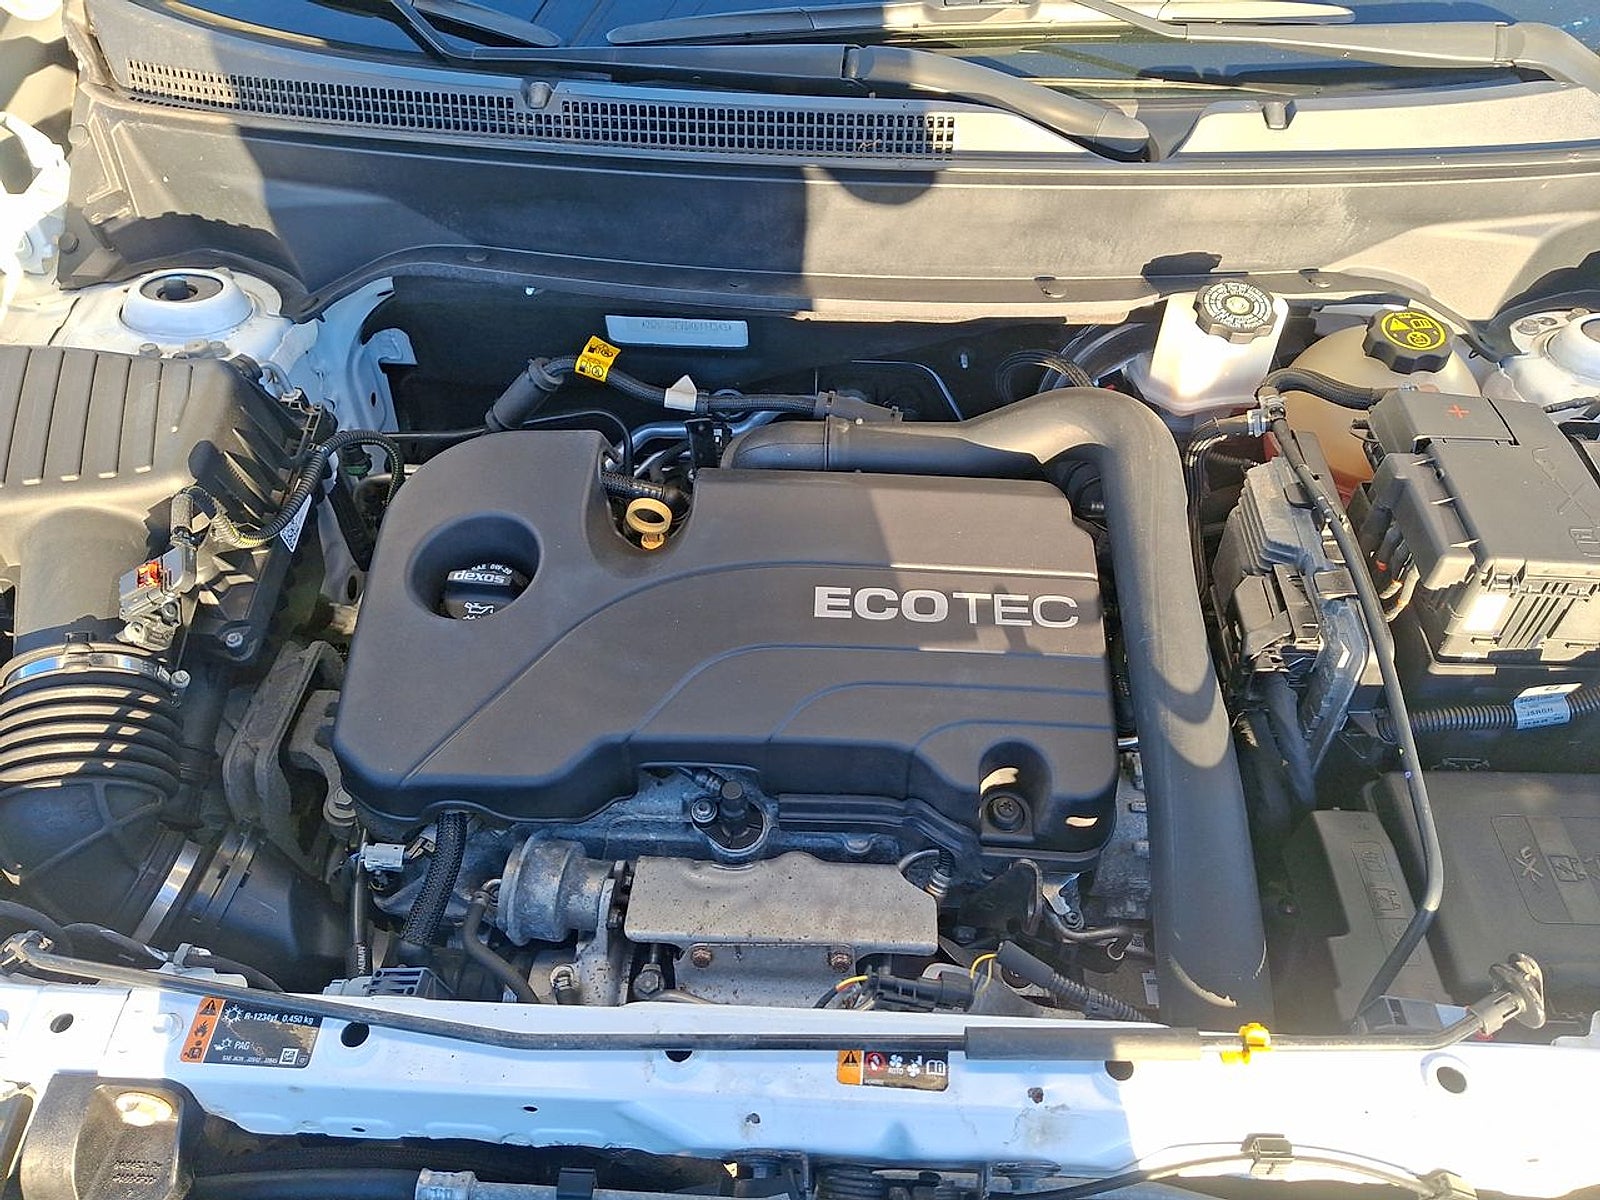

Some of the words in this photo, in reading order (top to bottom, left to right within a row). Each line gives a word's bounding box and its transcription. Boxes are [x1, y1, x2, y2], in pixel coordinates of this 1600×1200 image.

[453, 569, 506, 584] dexos
[814, 586, 1079, 628] ECOTEC
[303, 1016, 314, 1025] kg
[233, 1041, 250, 1050] PAG
